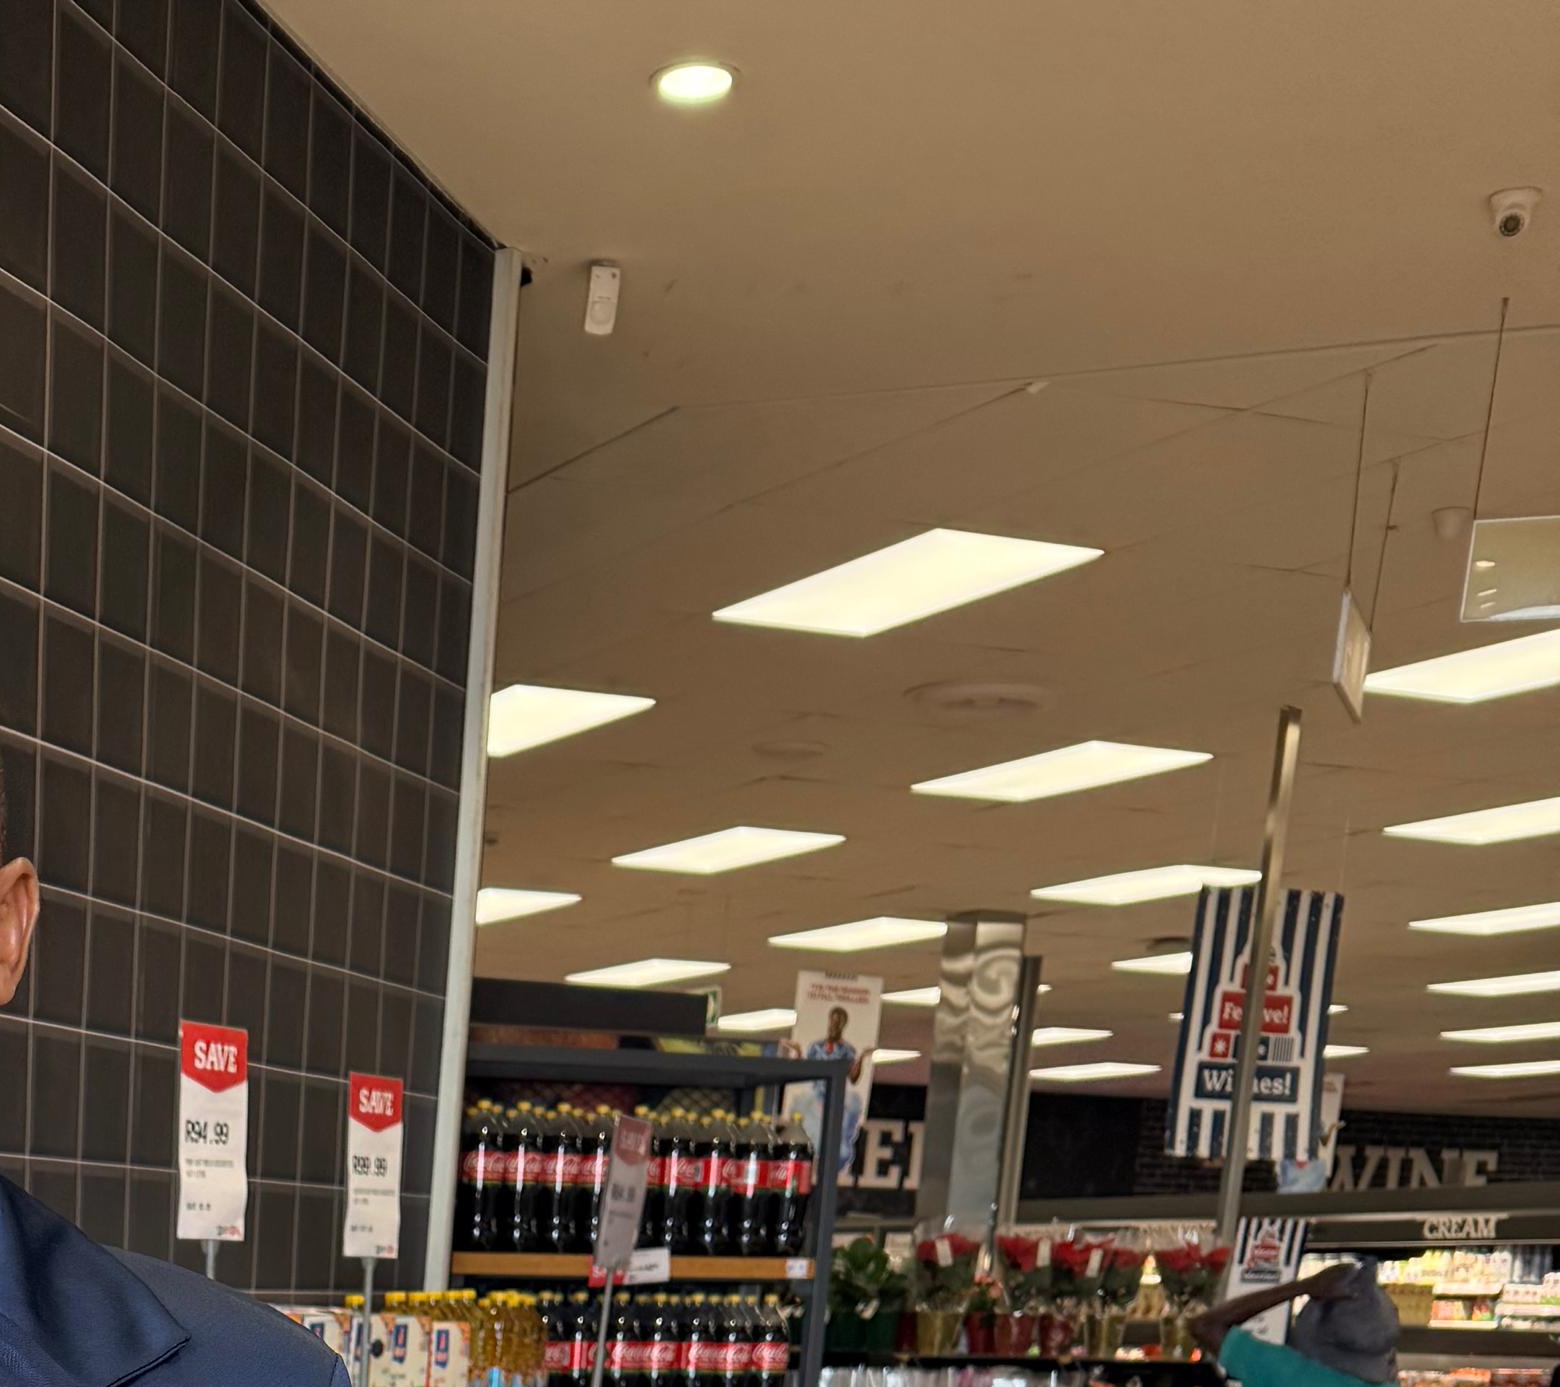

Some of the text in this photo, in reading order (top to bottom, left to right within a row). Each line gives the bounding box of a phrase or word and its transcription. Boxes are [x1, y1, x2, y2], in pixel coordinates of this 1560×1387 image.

[1223, 1002, 1289, 1025] Feve!
[193, 1039, 238, 1074] SAVE
[1203, 1068, 1292, 1096] Wies!
[358, 1087, 394, 1117] SAVE
[1422, 1215, 1499, 1239] CREAM
